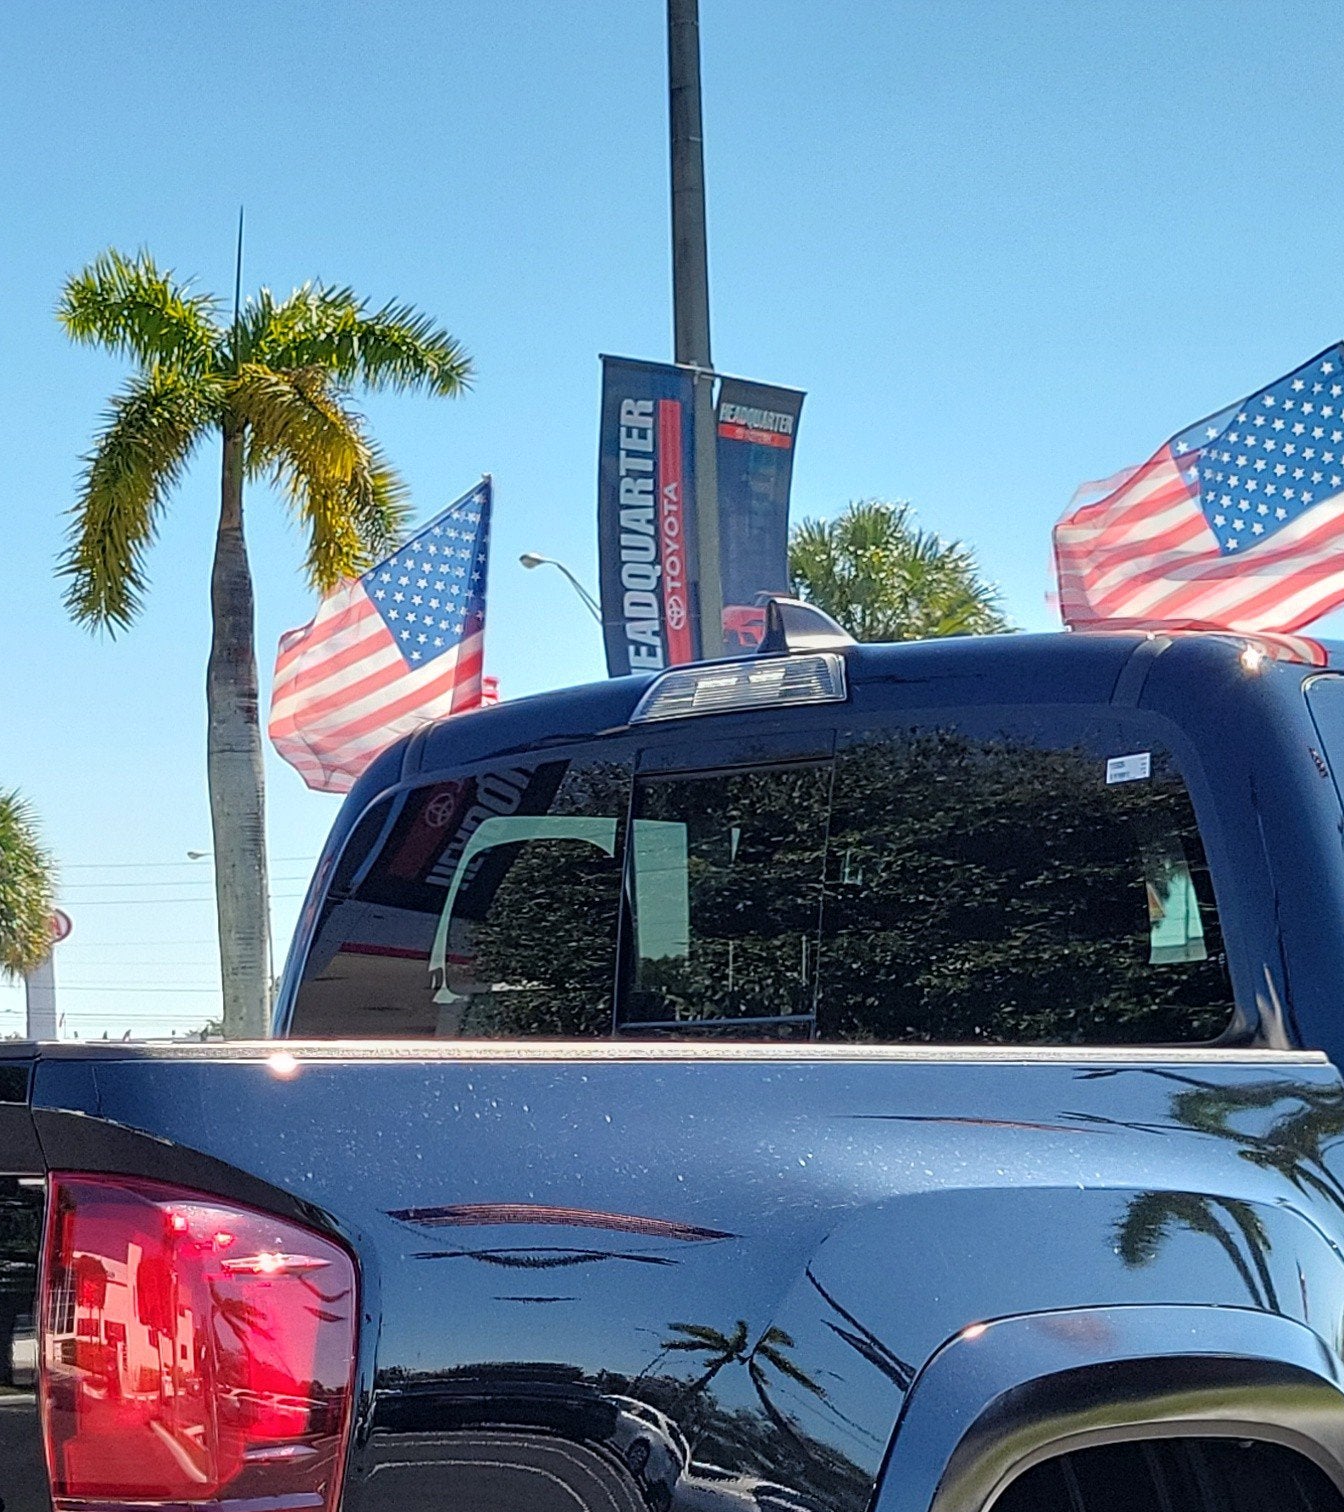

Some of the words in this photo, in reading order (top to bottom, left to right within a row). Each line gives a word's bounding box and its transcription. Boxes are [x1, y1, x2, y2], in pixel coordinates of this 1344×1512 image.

[719, 403, 794, 434] HEADQUARTER
[619, 397, 665, 676] EADQUARTER
[663, 481, 682, 592] TOYOTA
